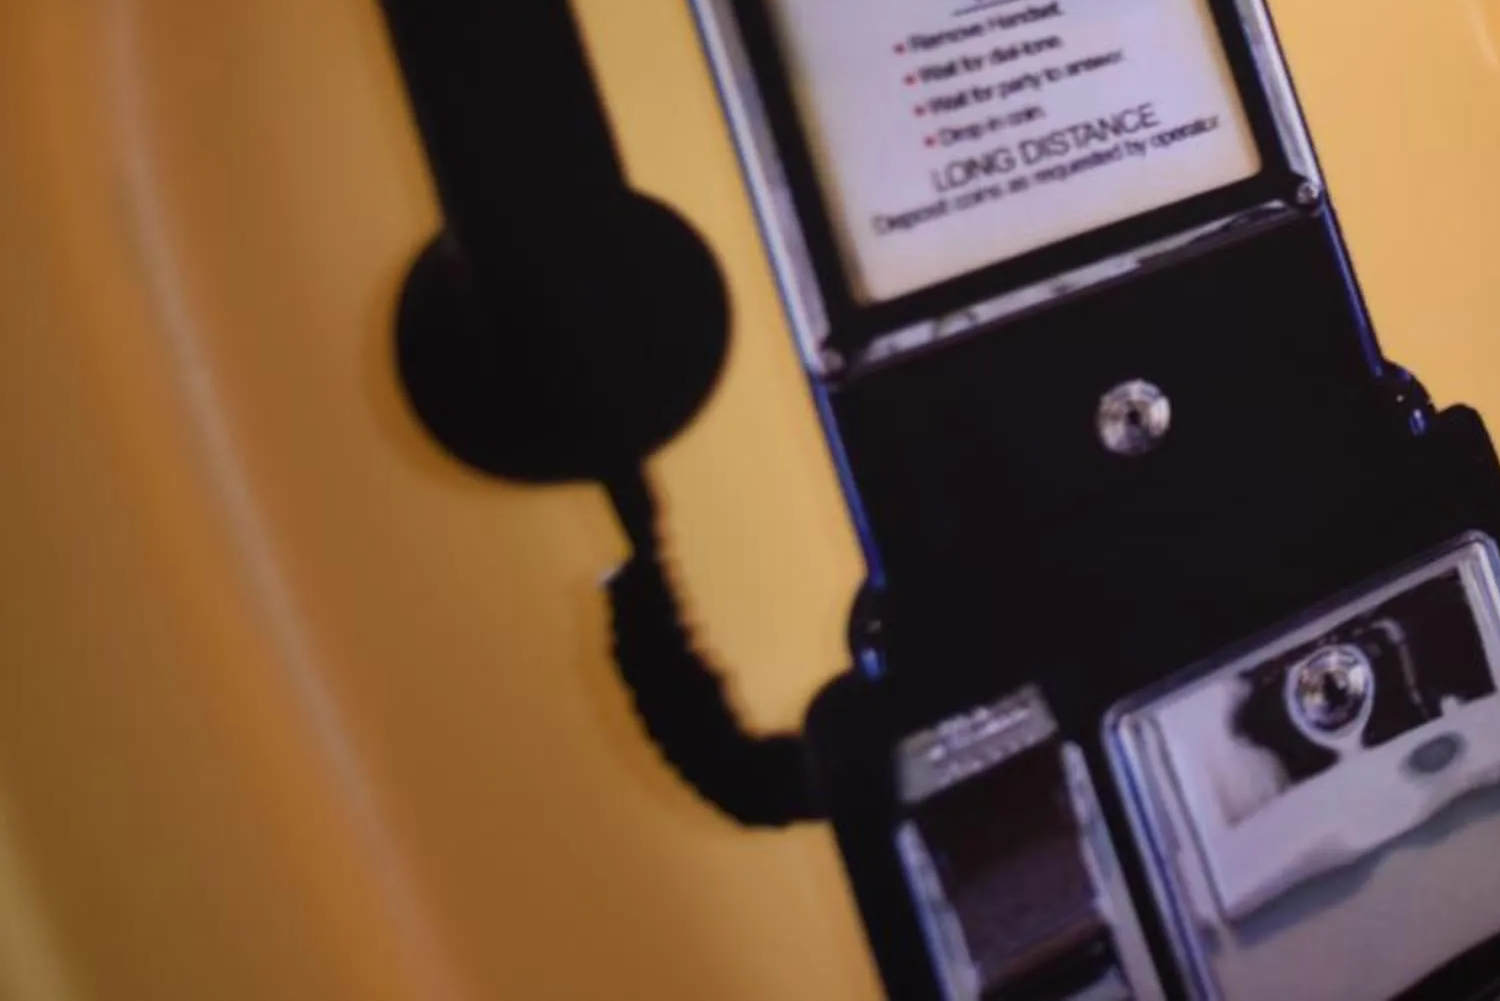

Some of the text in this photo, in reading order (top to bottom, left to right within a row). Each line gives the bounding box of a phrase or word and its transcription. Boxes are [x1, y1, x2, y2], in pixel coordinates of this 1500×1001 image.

[908, 23, 984, 50] Remove
[918, 60, 957, 83] Wait
[959, 55, 984, 72] for
[928, 91, 969, 114] Wait
[970, 86, 994, 102] for
[998, 72, 1043, 99] party
[1044, 66, 1063, 82] to
[930, 102, 1163, 194] LONG DISTANCE
[938, 123, 982, 148] Drop
[986, 116, 1005, 132] in
[871, 198, 949, 236] Deposit
[952, 183, 1003, 212] coins
[1006, 175, 1031, 194] as
[1032, 144, 1123, 182] requested
[1123, 135, 1149, 158] by
